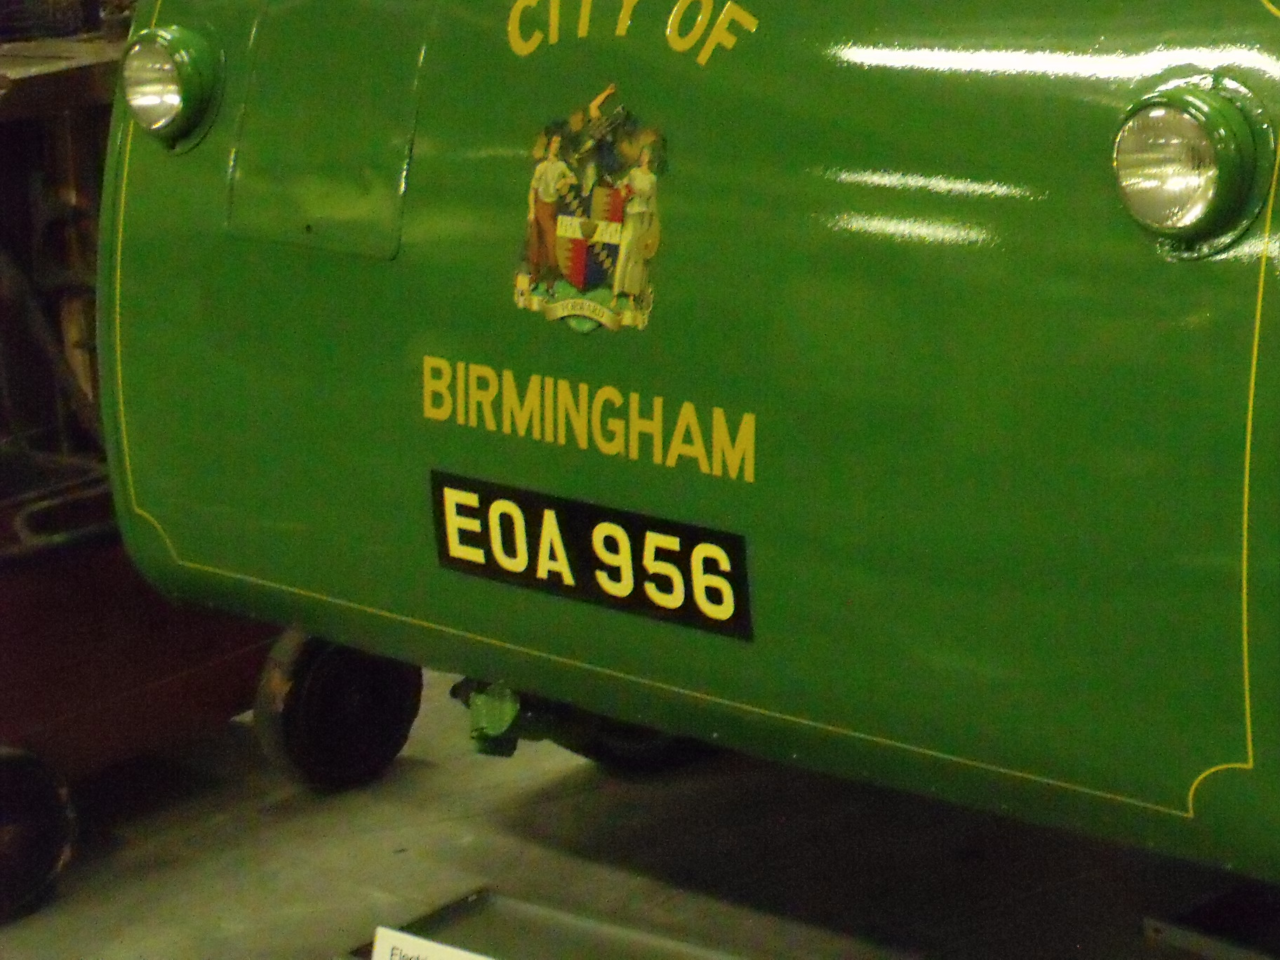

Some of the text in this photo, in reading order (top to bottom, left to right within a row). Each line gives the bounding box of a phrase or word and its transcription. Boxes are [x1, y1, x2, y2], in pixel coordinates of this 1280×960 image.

[423, 355, 756, 483] BIRMINGHAM
[443, 486, 736, 621] EOA 956
